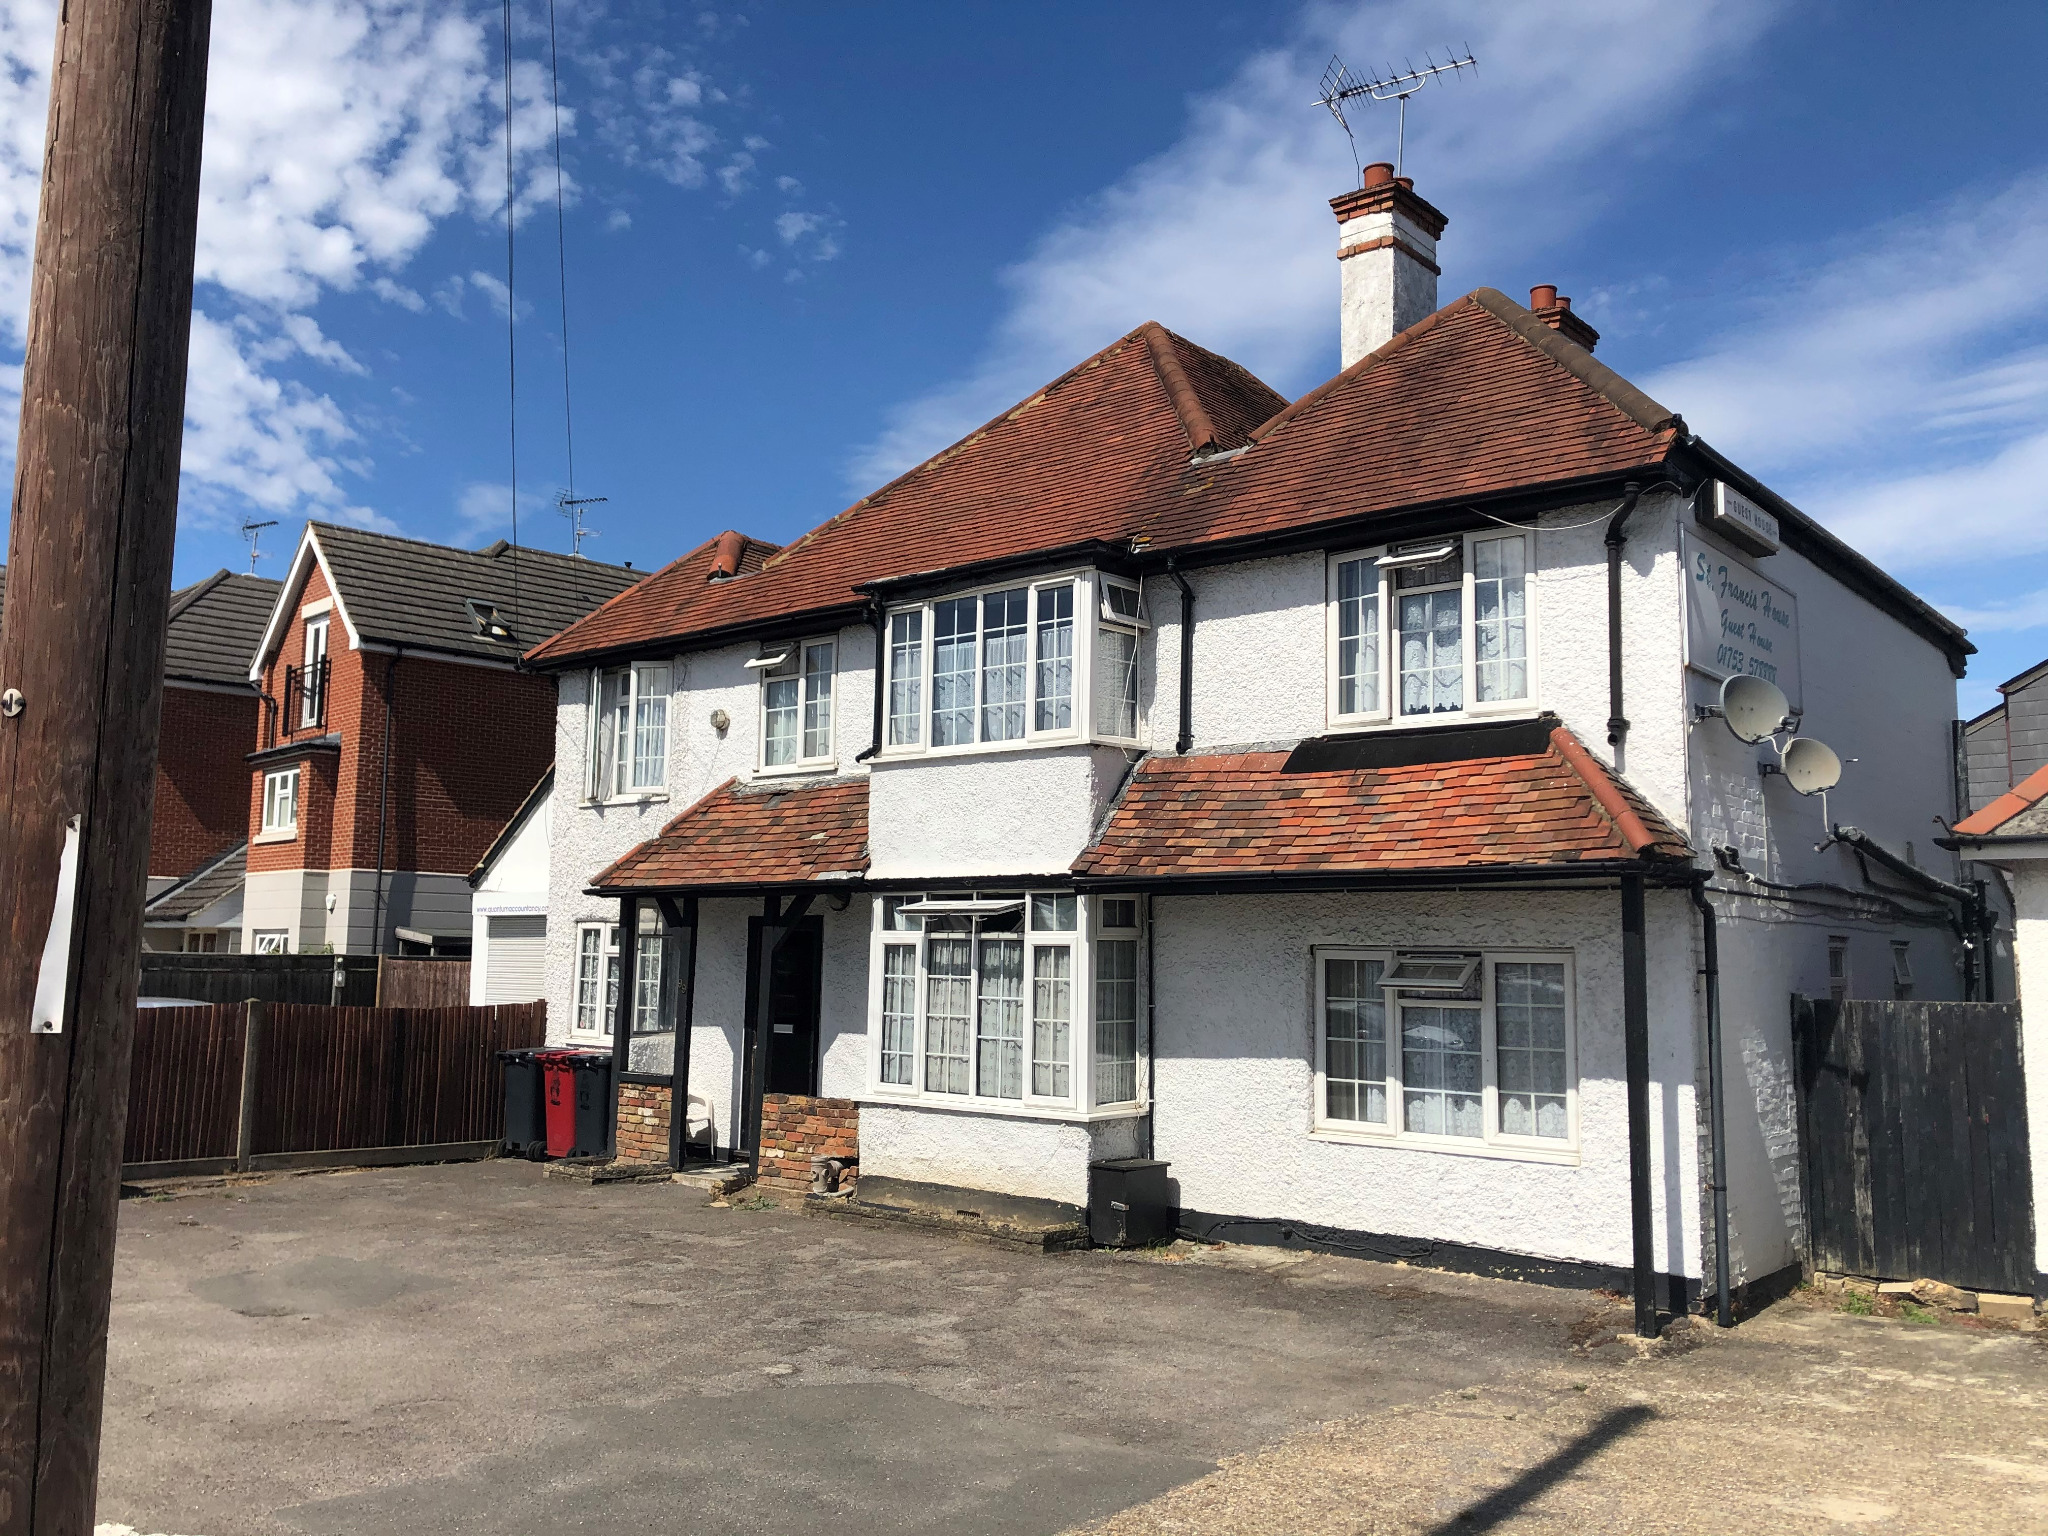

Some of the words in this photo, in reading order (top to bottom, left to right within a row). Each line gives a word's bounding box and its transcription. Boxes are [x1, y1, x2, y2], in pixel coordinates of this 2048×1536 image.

[1733, 500, 1752, 522] GUEST
[1696, 552, 1714, 591] St.
[1718, 565, 1758, 611] Francis
[1761, 590, 1790, 629] House
[1720, 608, 1745, 639] Guest
[1747, 622, 1773, 654] House
[1716, 643, 1744, 673] 01753
